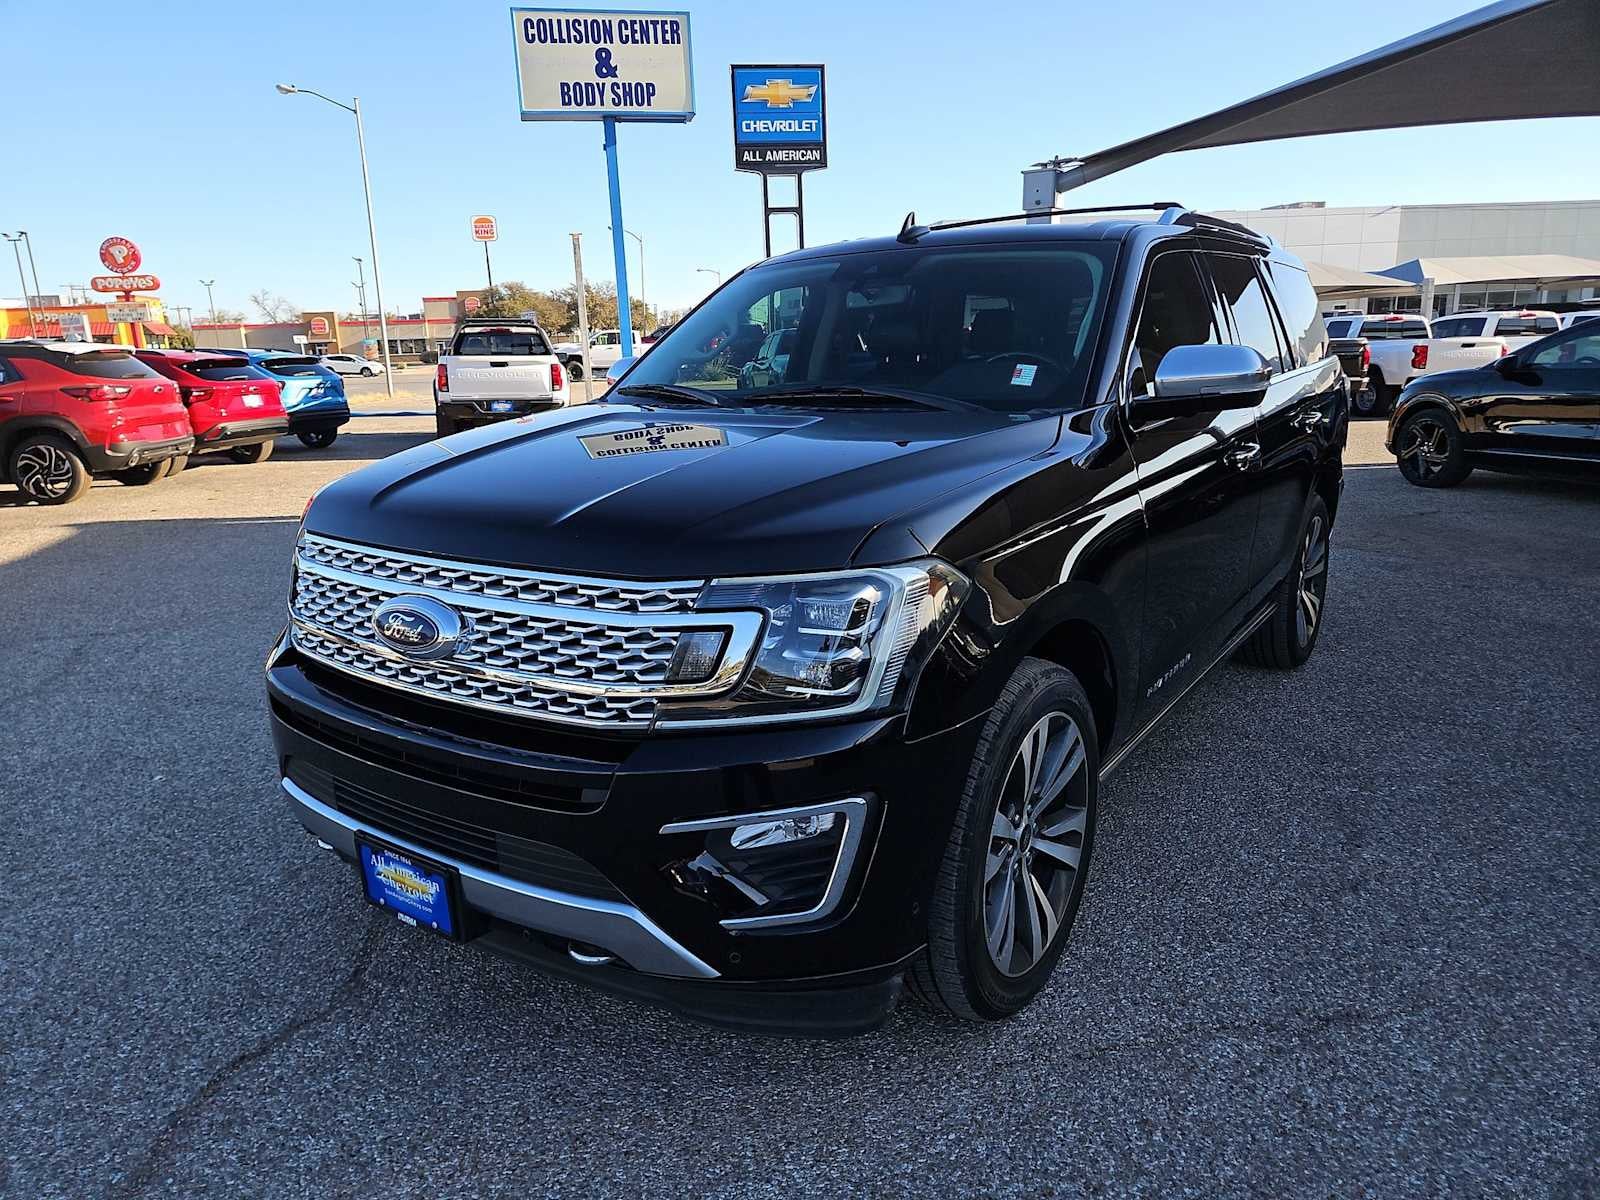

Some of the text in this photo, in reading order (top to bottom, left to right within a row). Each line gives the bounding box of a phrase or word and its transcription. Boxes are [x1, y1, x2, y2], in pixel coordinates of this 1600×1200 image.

[523, 18, 681, 44] COLLISION CENTER
[594, 47, 618, 78] &
[560, 82, 656, 106] BODY SHOP
[742, 120, 818, 132] CHEVROLET
[743, 150, 820, 161] ALL AMERICAN
[384, 612, 423, 642] Ford
[370, 854, 385, 867] All
